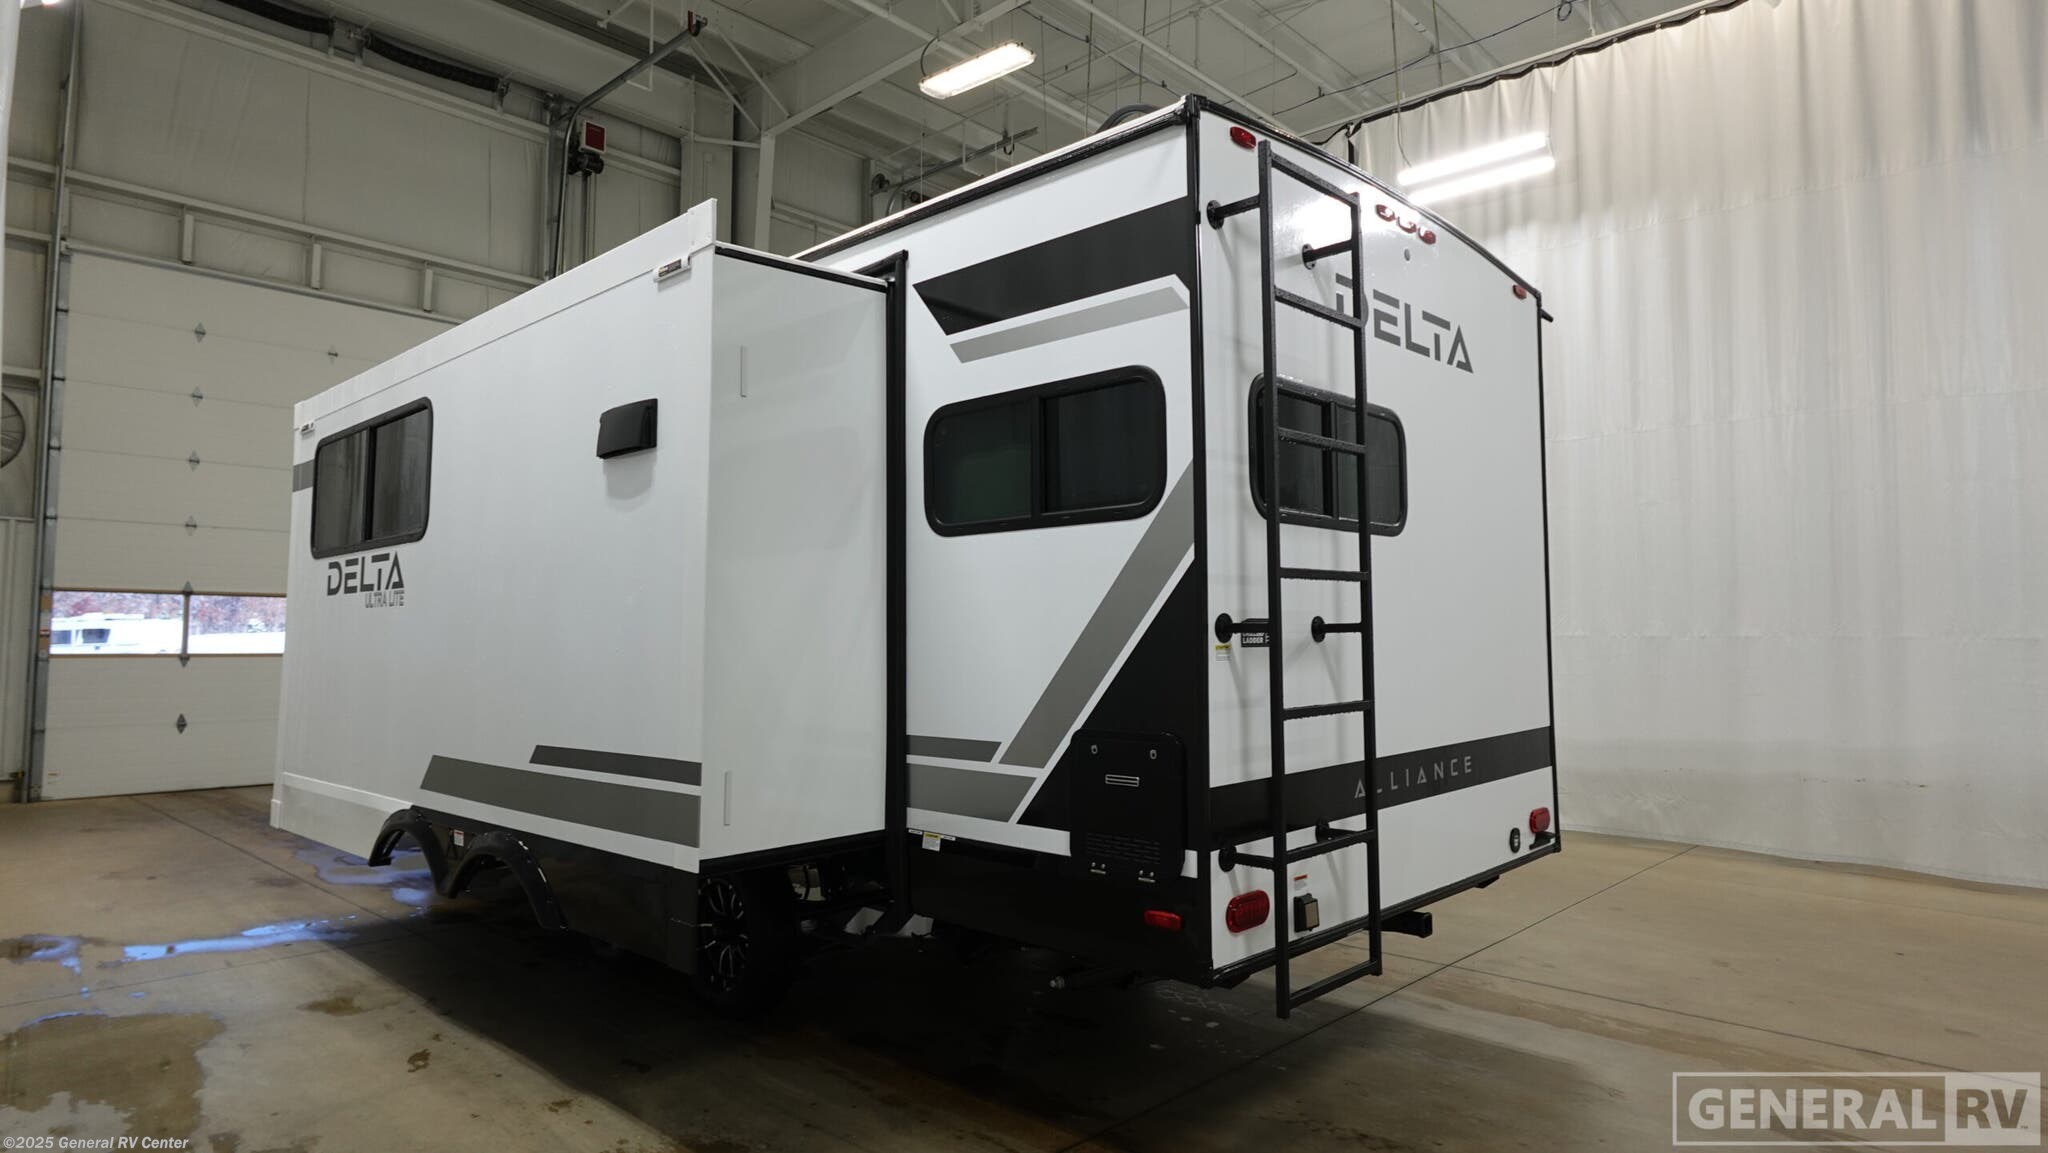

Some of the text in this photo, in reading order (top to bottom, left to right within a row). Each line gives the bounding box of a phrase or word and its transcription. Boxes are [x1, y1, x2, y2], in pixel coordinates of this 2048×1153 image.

[327, 552, 405, 596] DELTA
[365, 590, 405, 608] ULTRA LITE
[1354, 756, 1473, 799] ALIANCE
